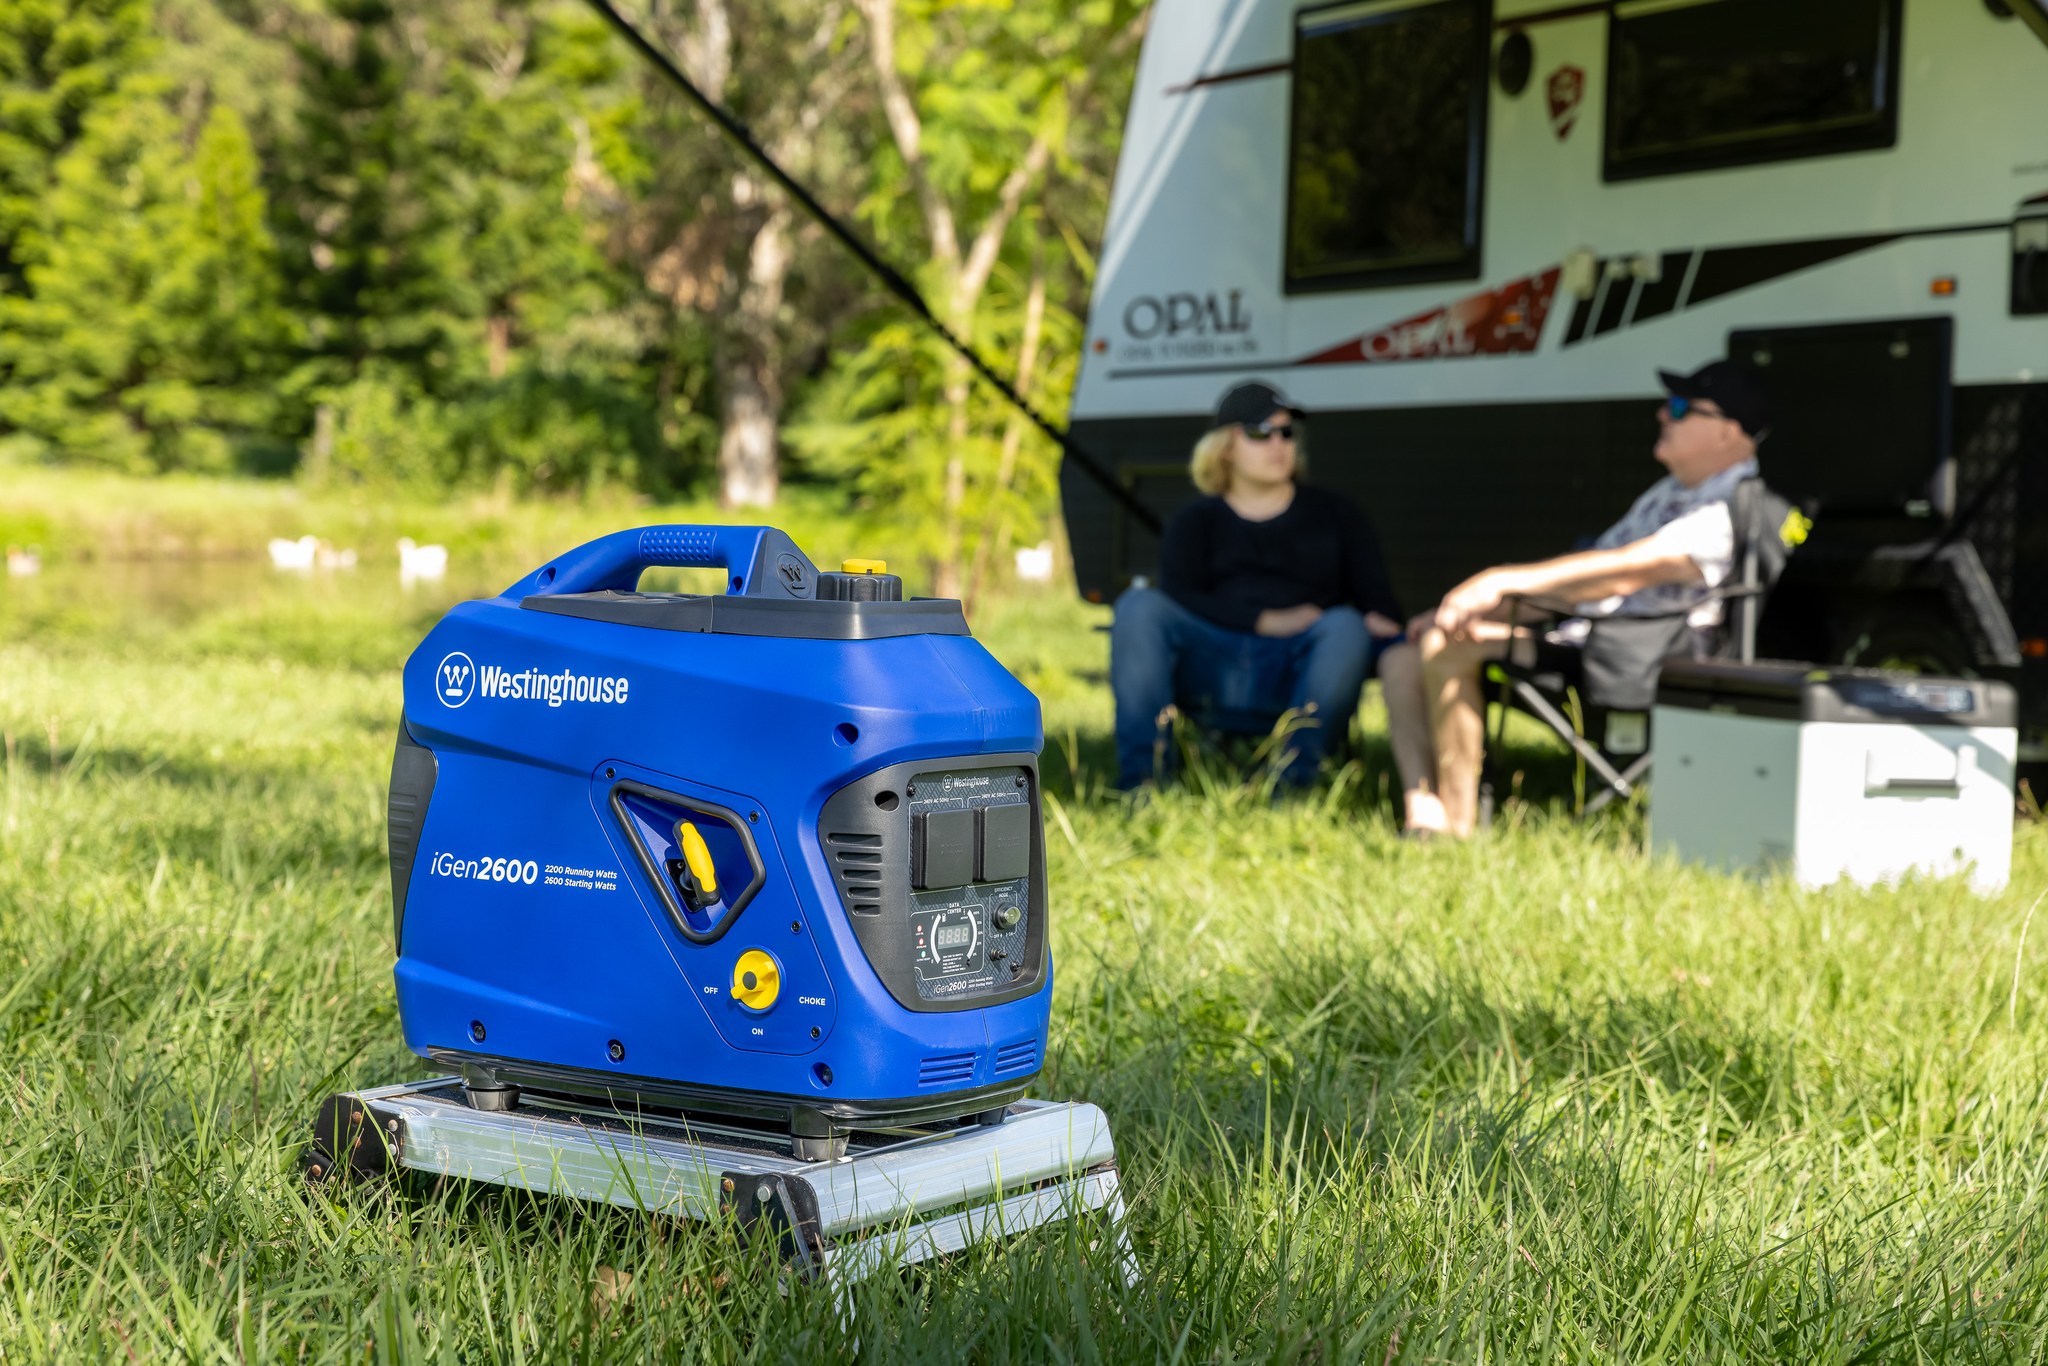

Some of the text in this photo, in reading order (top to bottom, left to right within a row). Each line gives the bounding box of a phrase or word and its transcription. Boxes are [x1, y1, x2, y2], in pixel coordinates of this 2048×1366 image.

[1123, 288, 1252, 340] OPAL
[1361, 318, 1476, 361] OPAL
[480, 665, 629, 708] Westinghouse
[953, 776, 989, 789] Westinghouse
[430, 851, 617, 885] iGen2600 2200 Running Watts
[544, 876, 616, 891] 2600 Starting Watts
[703, 986, 719, 995] OFF
[933, 980, 967, 994] iGen2600
[799, 996, 826, 1006] CHOKE
[751, 1027, 764, 1036] ON
